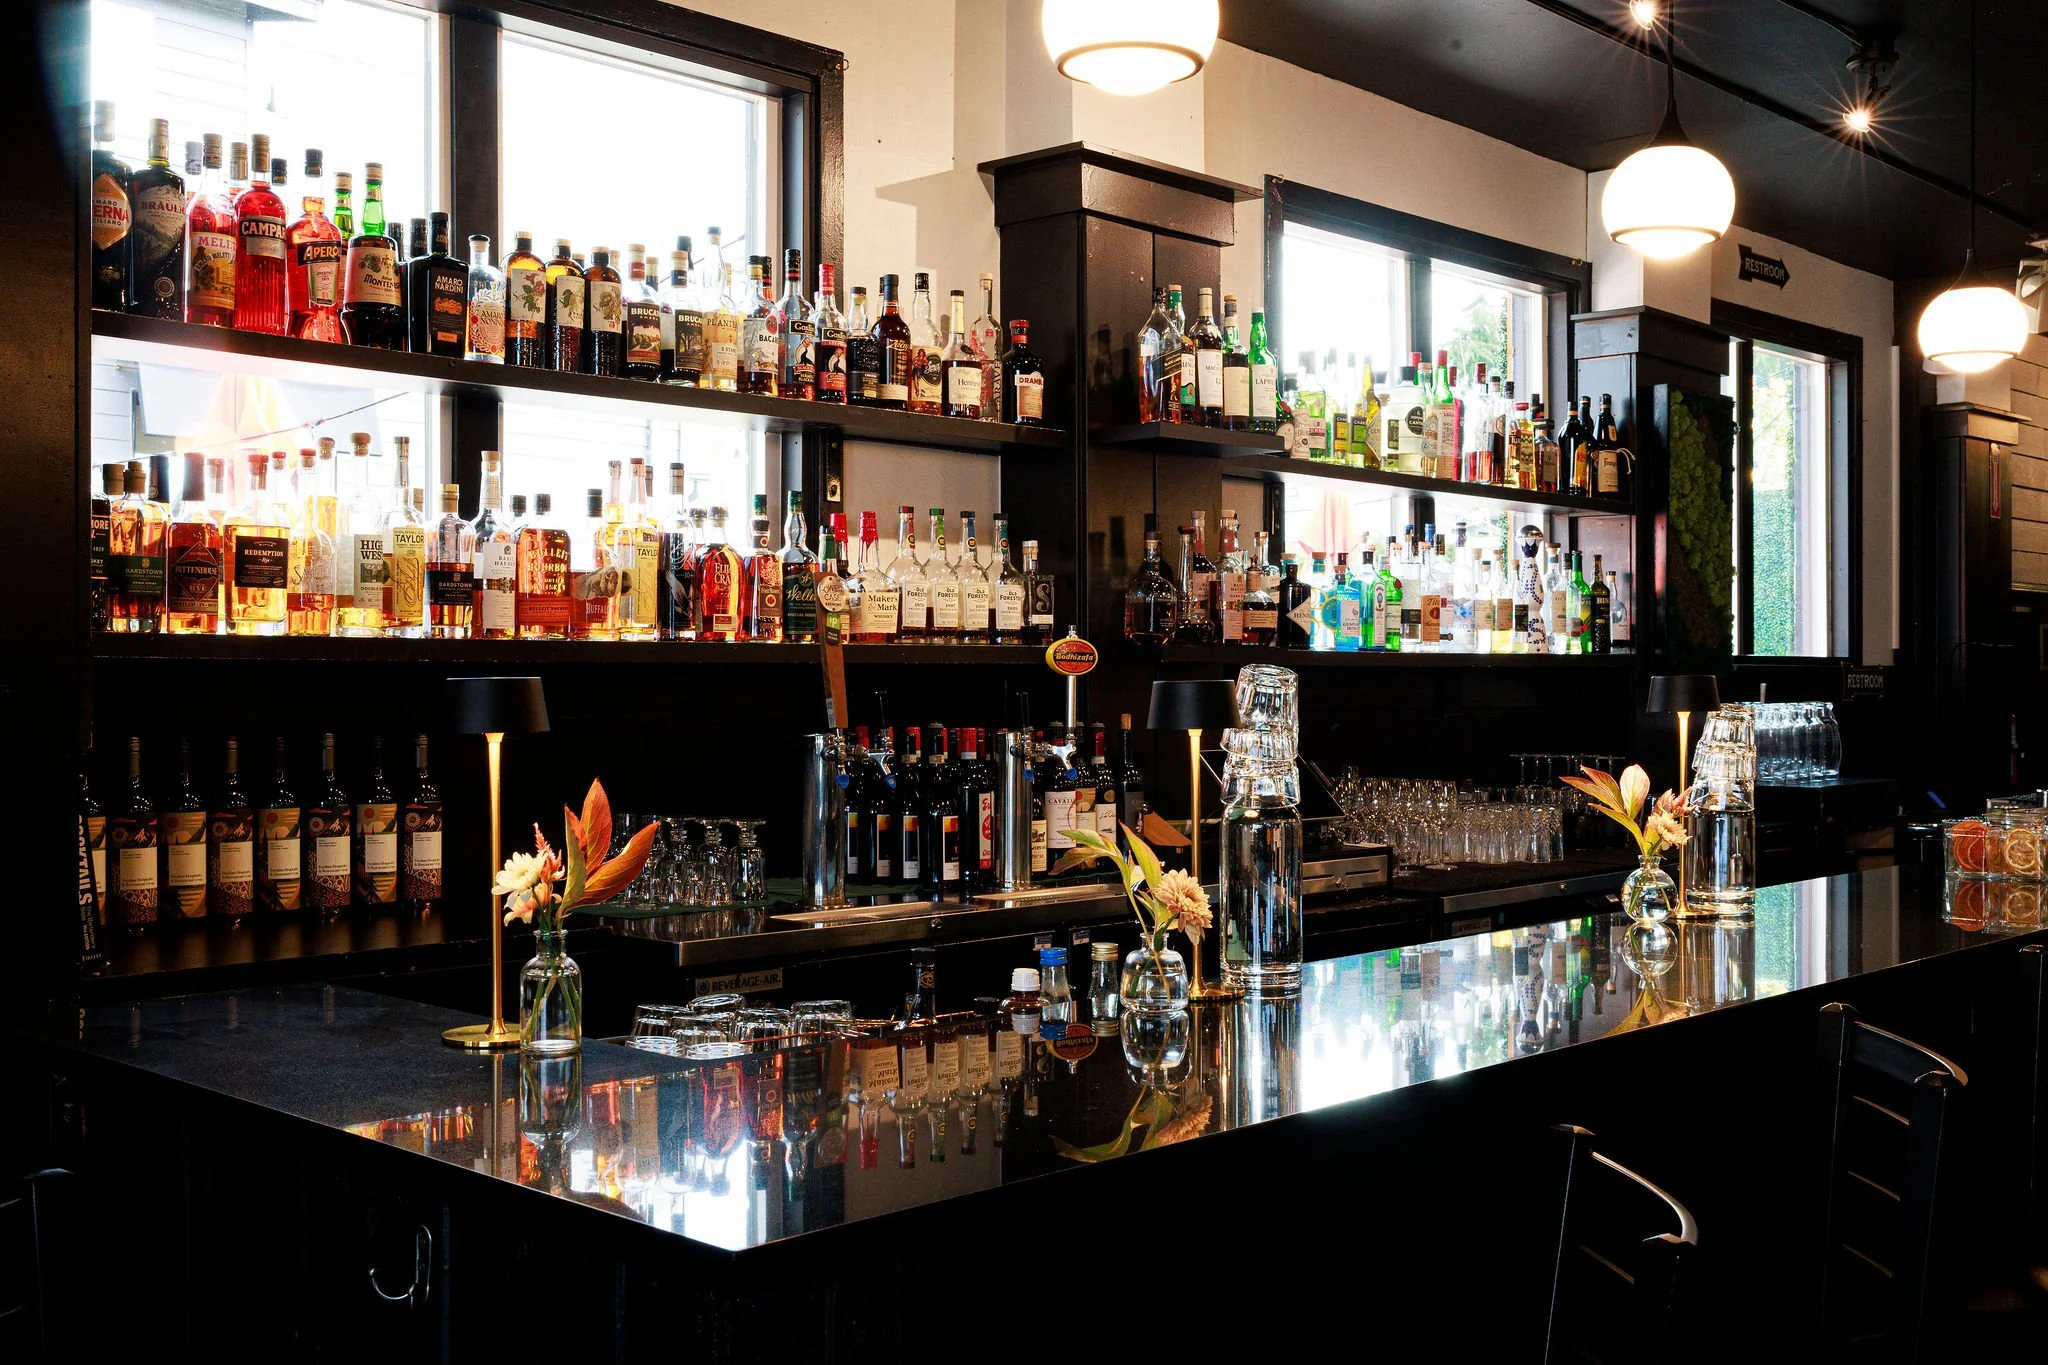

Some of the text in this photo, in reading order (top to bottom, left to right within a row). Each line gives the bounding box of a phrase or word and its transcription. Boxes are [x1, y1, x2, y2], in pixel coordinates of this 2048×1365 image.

[1745, 257, 1784, 281] RESTROOM
[436, 275, 463, 286] AMARO
[434, 282, 465, 295] NARDINI
[395, 534, 425, 544] TAYLOR
[244, 549, 285, 558] REDEMPTION
[528, 547, 569, 561] BULLEIT
[125, 568, 163, 576] BARDSTOWN
[175, 565, 218, 576] RITTENHOUSE
[868, 594, 899, 603] Maker's
[877, 603, 898, 611] Mark
[1055, 652, 1094, 662] Bodhizafa
[1847, 674, 1884, 689] RESTROOM
[78, 814, 93, 906] COCKTAILS
[712, 974, 779, 992] BEVERAGE-AIR
